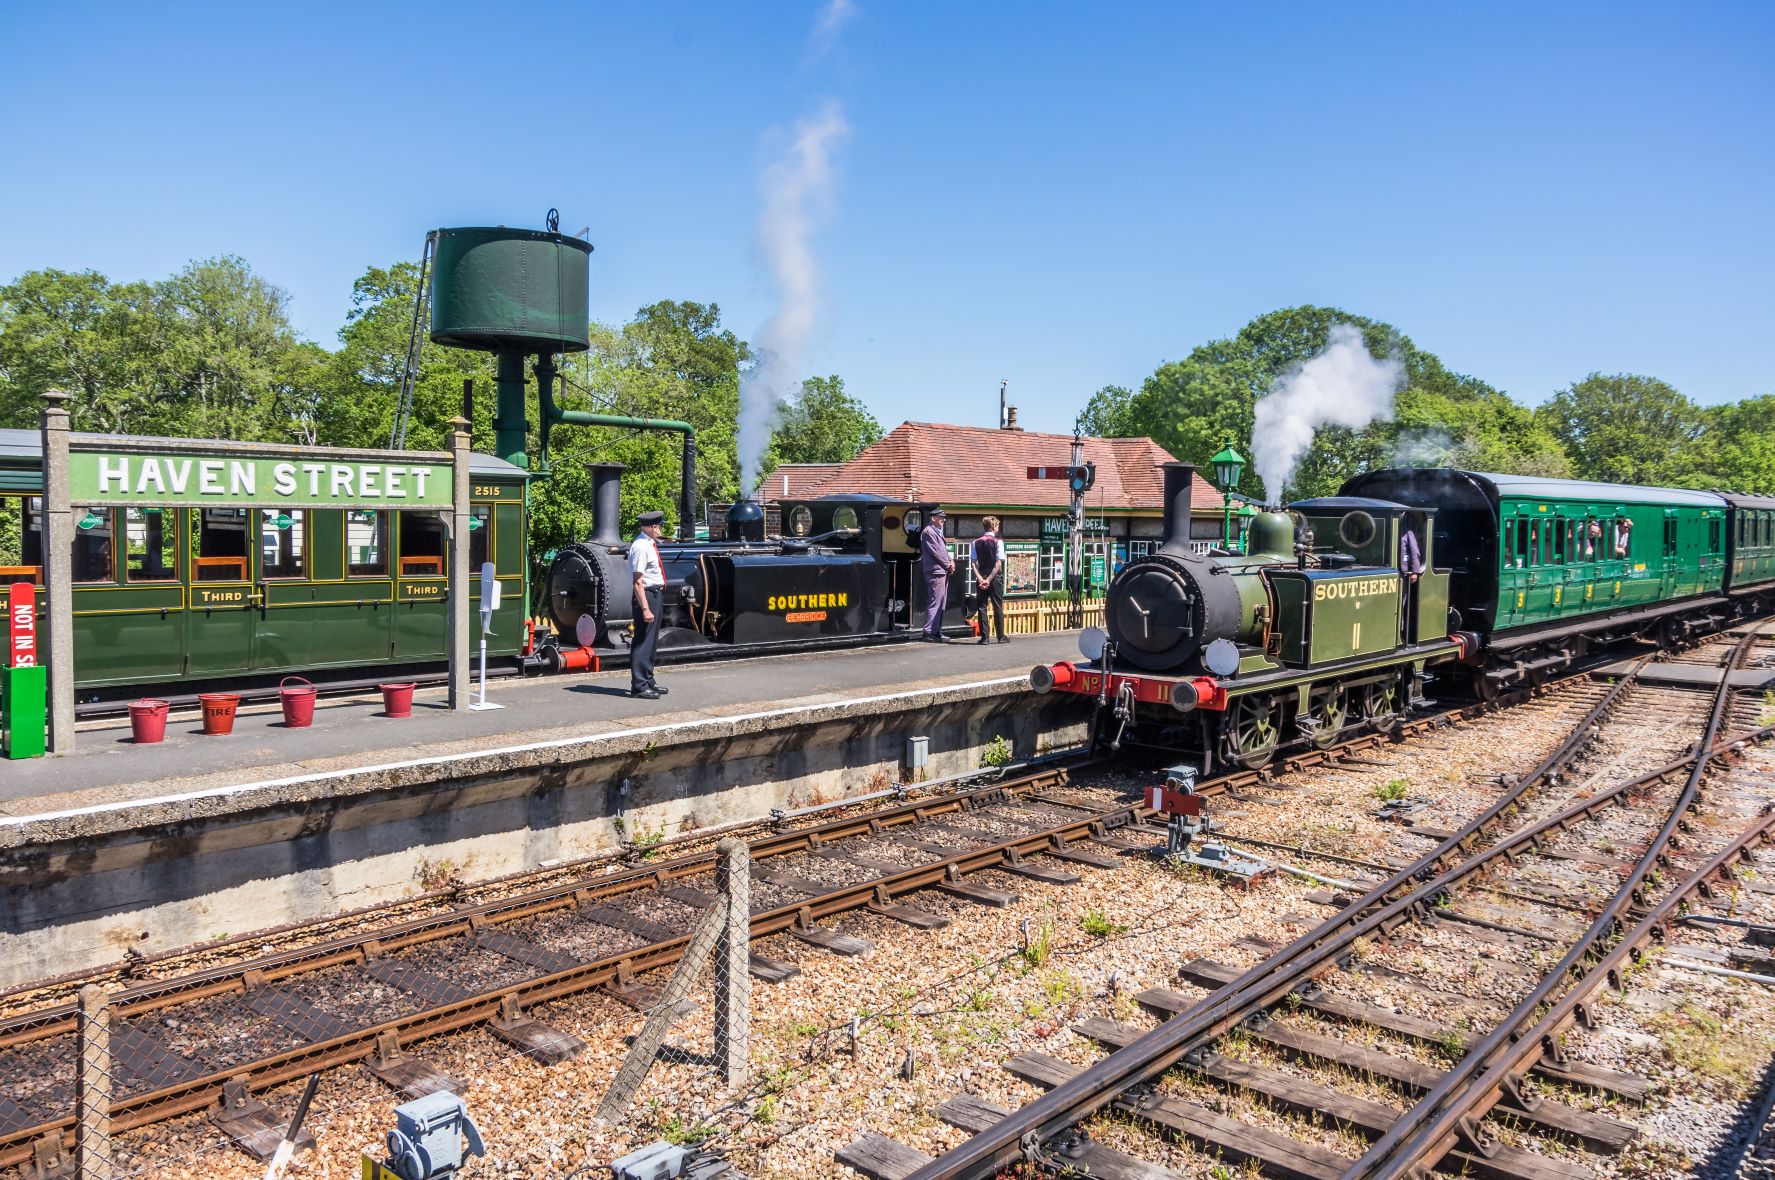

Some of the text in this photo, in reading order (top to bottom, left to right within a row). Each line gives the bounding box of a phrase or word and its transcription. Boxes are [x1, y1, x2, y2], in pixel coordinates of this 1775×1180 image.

[98, 456, 432, 499] HAVEN STREET
[475, 486, 500, 496] 2515
[1315, 578, 1398, 601] SOUTHERN
[768, 592, 847, 611] SOUTHERN
[14, 604, 33, 631] NOT
[15, 635, 34, 650] IN
[205, 707, 231, 717] FIRE
